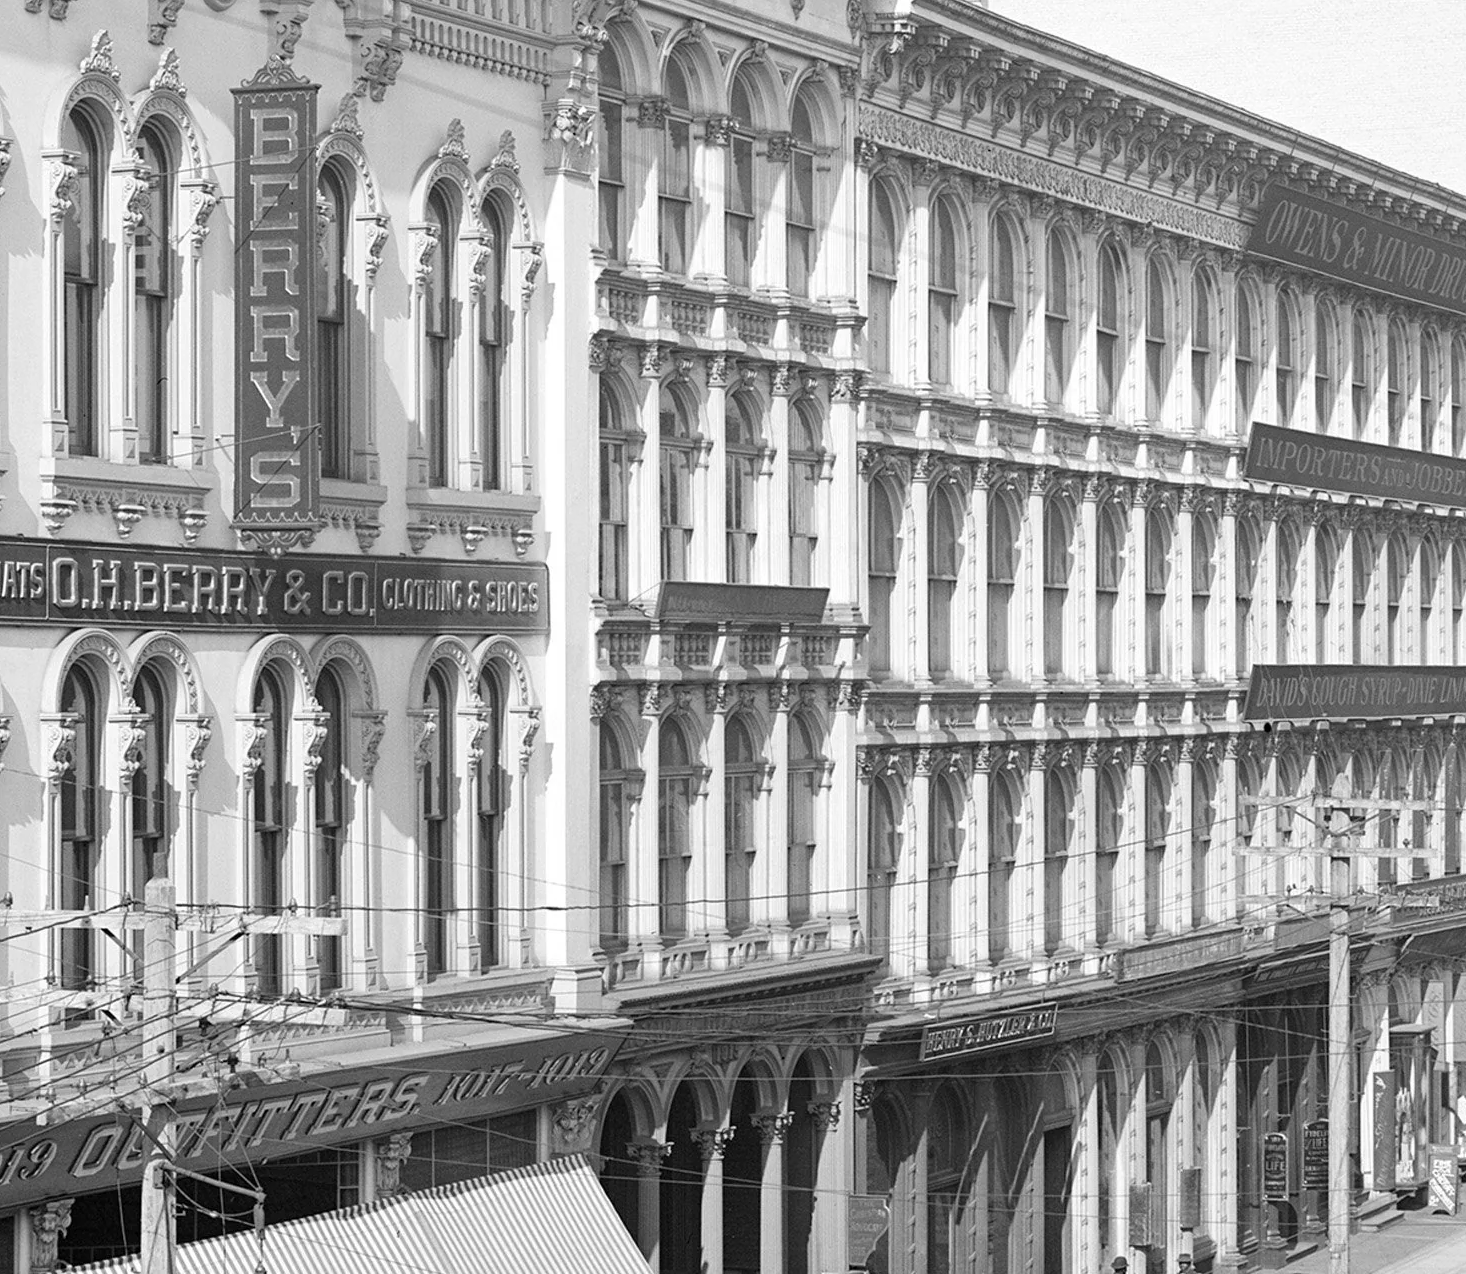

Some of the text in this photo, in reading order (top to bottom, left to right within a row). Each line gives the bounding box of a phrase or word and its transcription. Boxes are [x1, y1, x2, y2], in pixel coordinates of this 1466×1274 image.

[1265, 199, 1349, 264] OWENS
[1342, 226, 1367, 271] &
[1364, 233, 1436, 291] MINOR
[249, 107, 301, 508] BERRY'S
[1256, 437, 1383, 485] IMPORTERS
[1381, 468, 1406, 488] AND
[283, 569, 312, 616] &
[322, 570, 375, 618] CO.
[381, 578, 463, 612] CLOTHING
[467, 580, 483, 610] &
[485, 580, 540, 614] SHOES
[1311, 676, 1357, 706] COUGH
[925, 1026, 965, 1053] HENRY
[434, 1046, 611, 1106] 1017-1019
